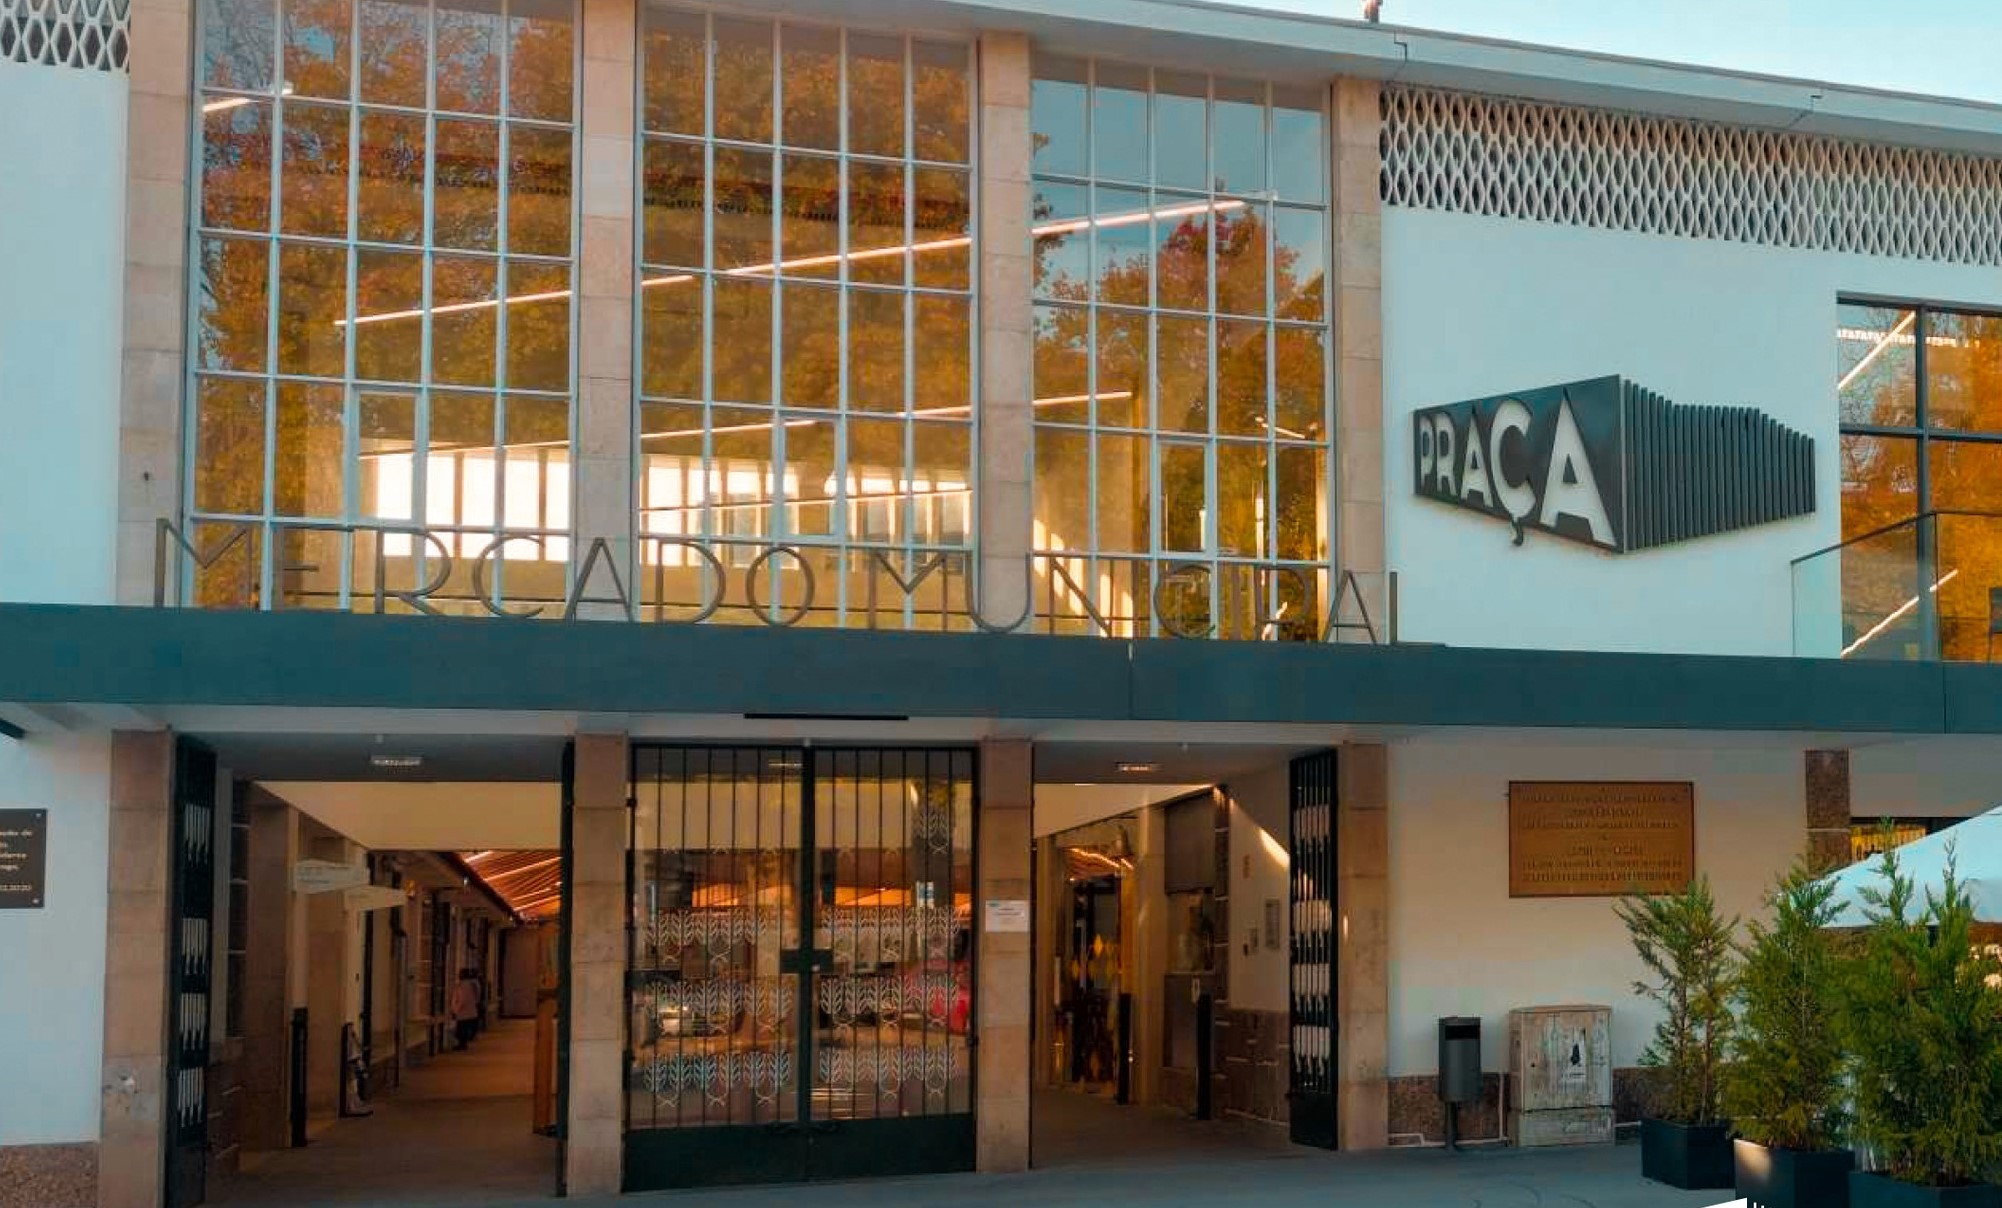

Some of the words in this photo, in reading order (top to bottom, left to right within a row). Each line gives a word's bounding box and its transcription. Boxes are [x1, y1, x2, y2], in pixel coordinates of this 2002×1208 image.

[1419, 387, 1618, 546] PRAÇA
[153, 517, 816, 627] MERCADO
[866, 545, 1446, 646] MUNICIPAL
